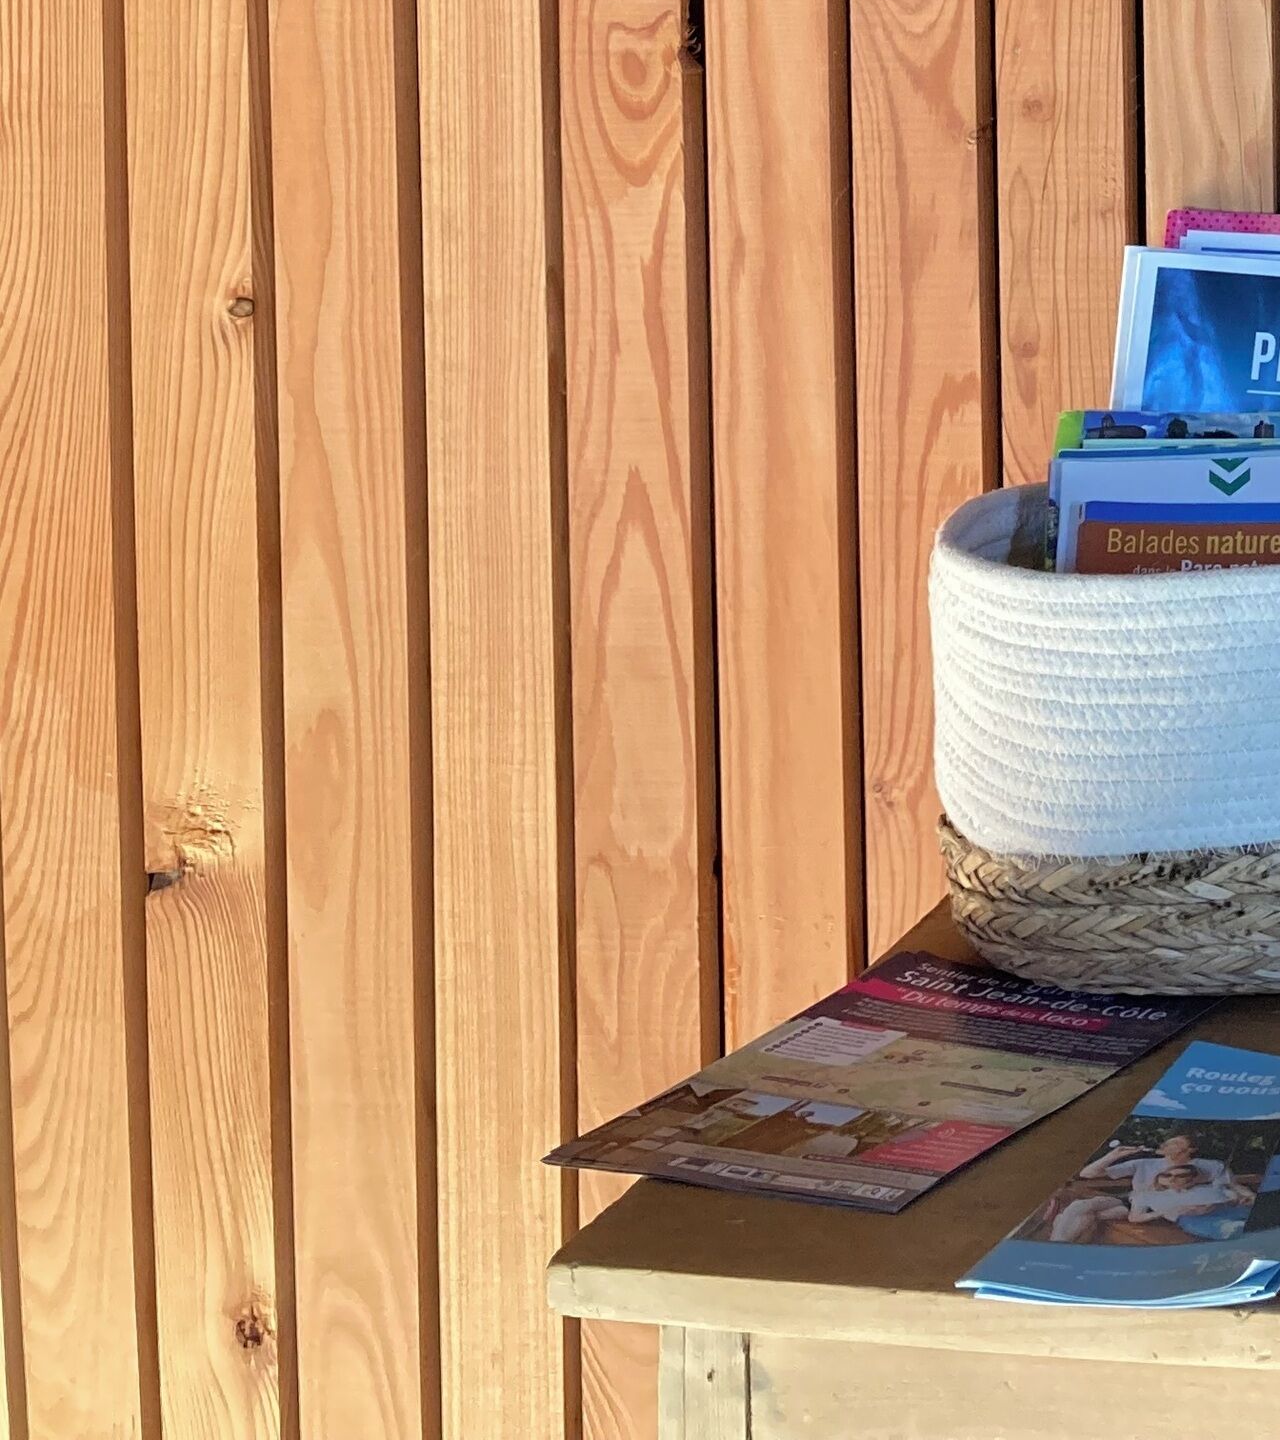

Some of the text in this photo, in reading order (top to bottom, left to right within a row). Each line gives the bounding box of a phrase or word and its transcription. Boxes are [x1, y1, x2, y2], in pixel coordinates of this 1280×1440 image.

[1106, 528, 1200, 555] Balades
[914, 962, 978, 983] Sentier
[979, 976, 999, 988] de
[896, 970, 1168, 1022] Saint Jean-de-Côle
[932, 995, 998, 1015] temps
[1186, 1067, 1276, 1086] Roulez
[1180, 1082, 1212, 1095] ça
[1216, 1085, 1280, 1095] vous
